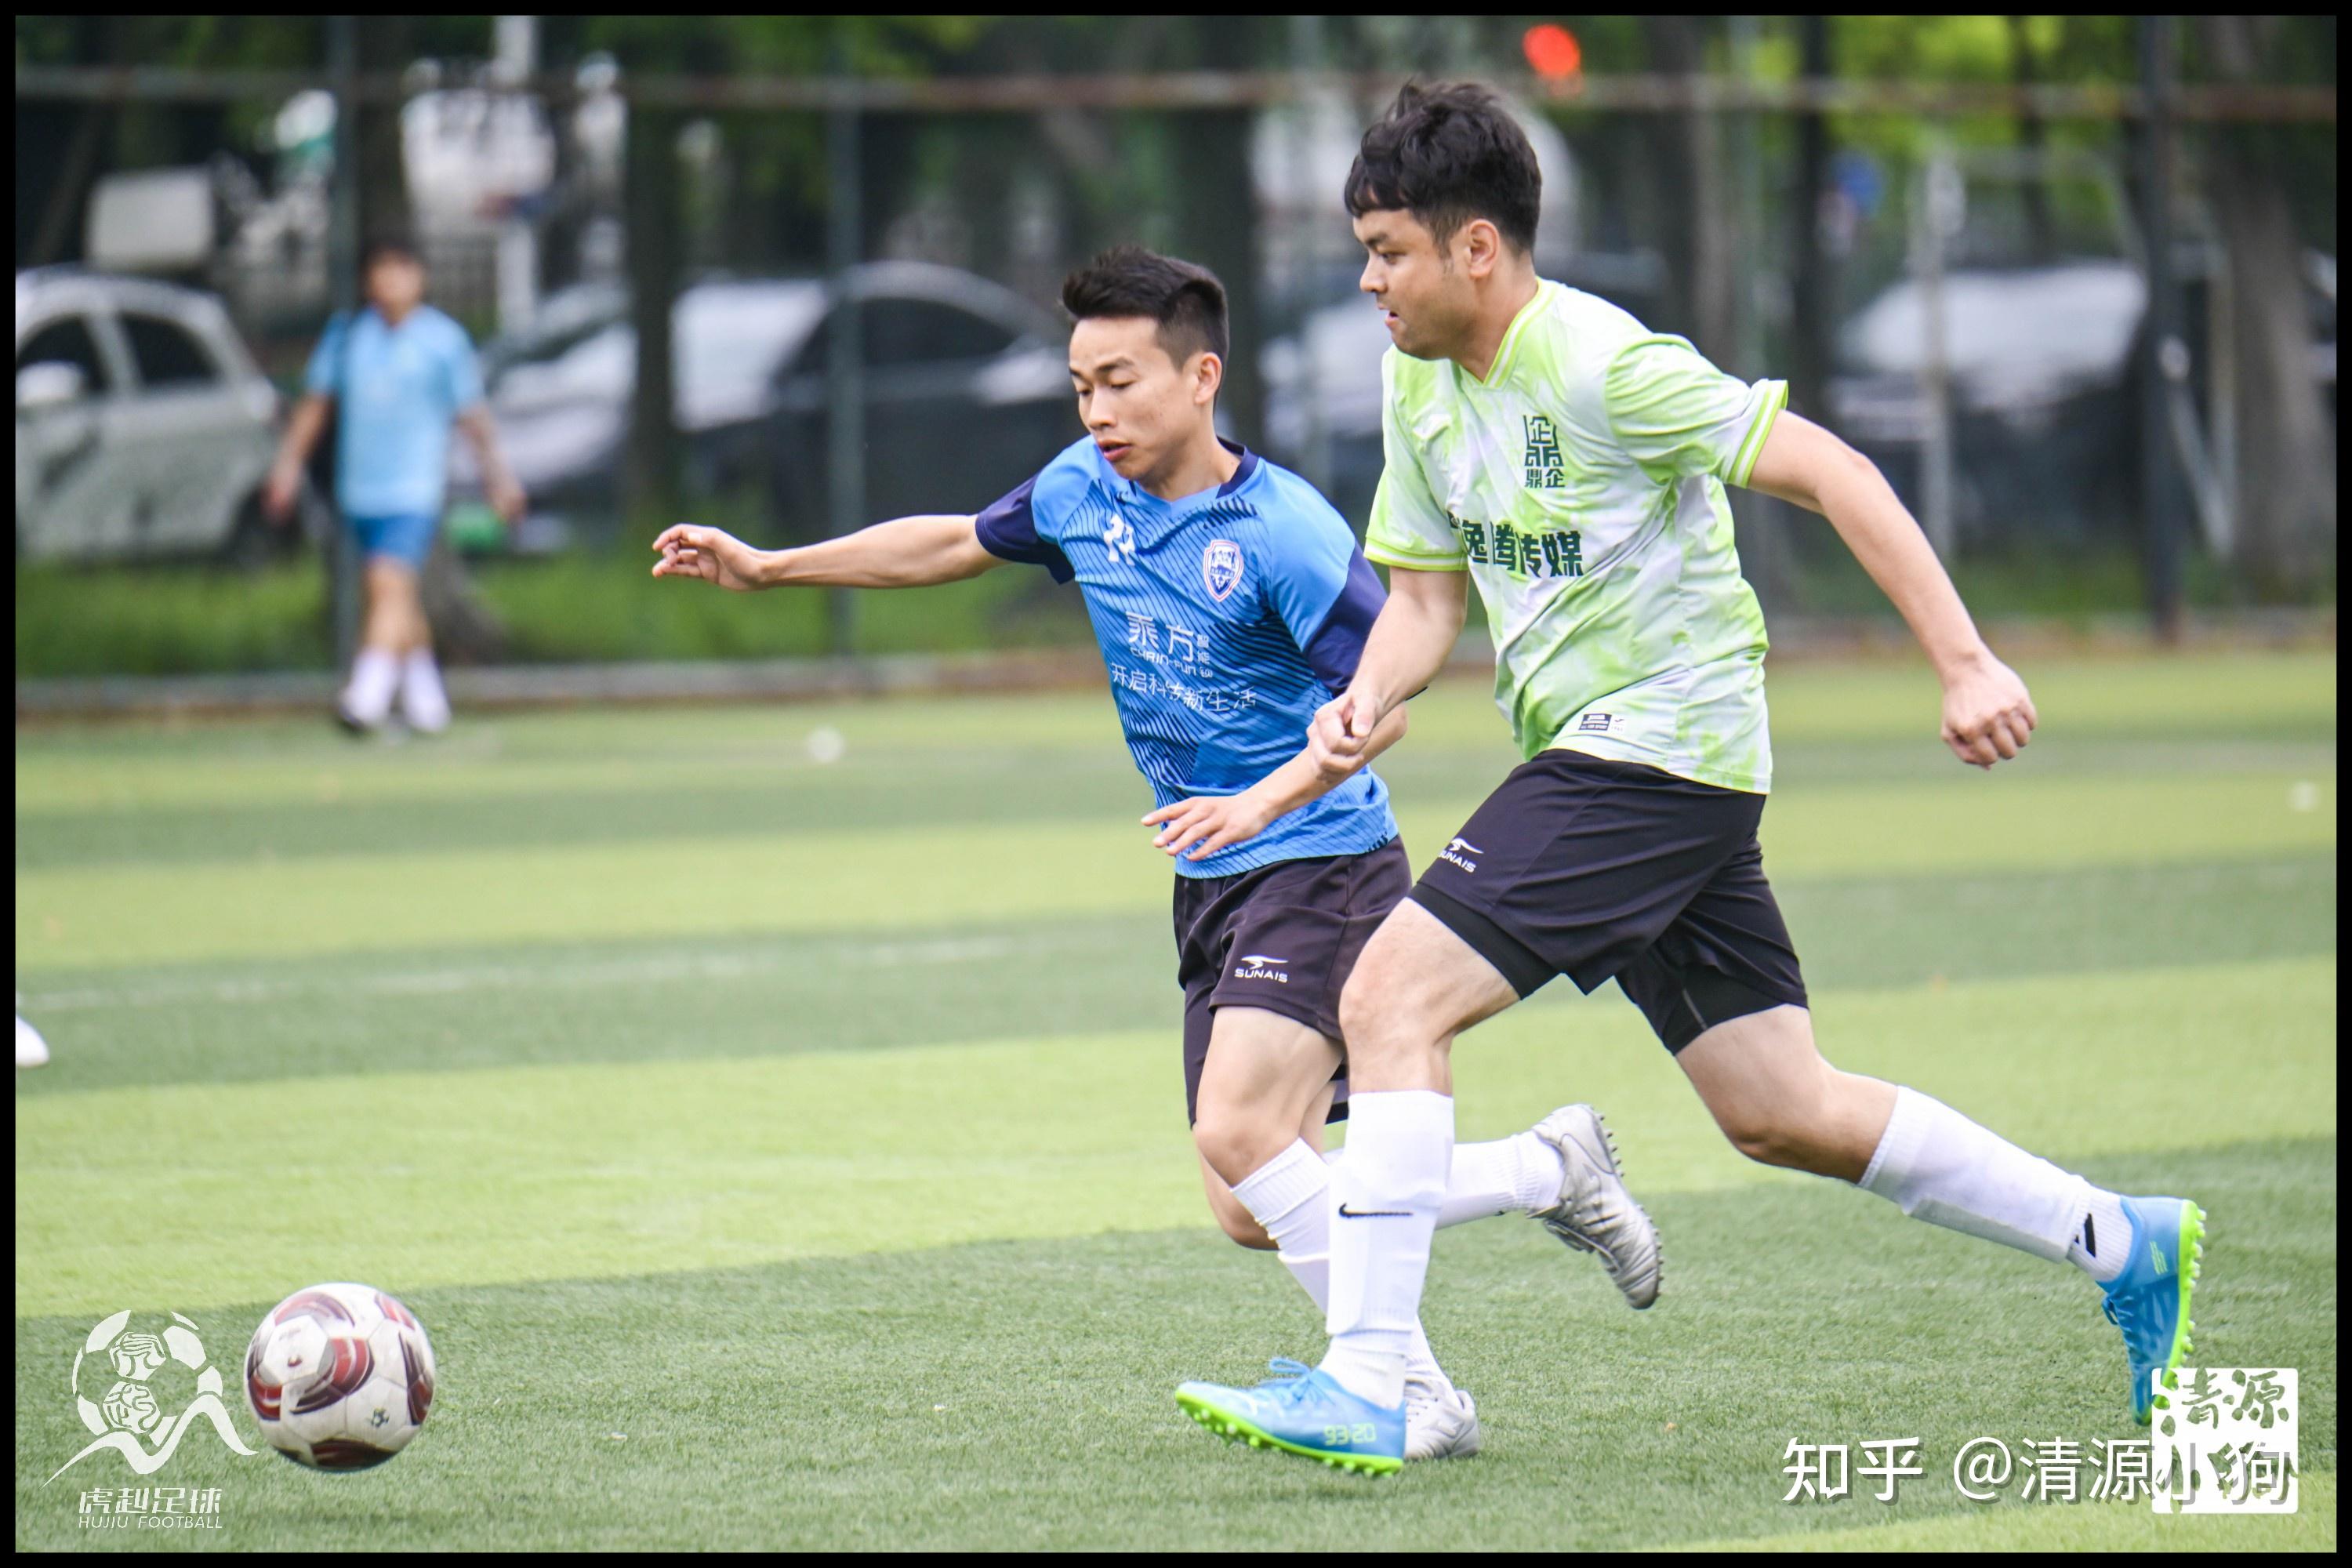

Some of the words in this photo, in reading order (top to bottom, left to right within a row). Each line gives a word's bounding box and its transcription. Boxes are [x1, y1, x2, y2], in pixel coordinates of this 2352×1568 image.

[1525, 468, 1566, 488] 鼎企
[1126, 611, 1195, 662] 乘方
[1234, 967, 1288, 984] SUNAIS
